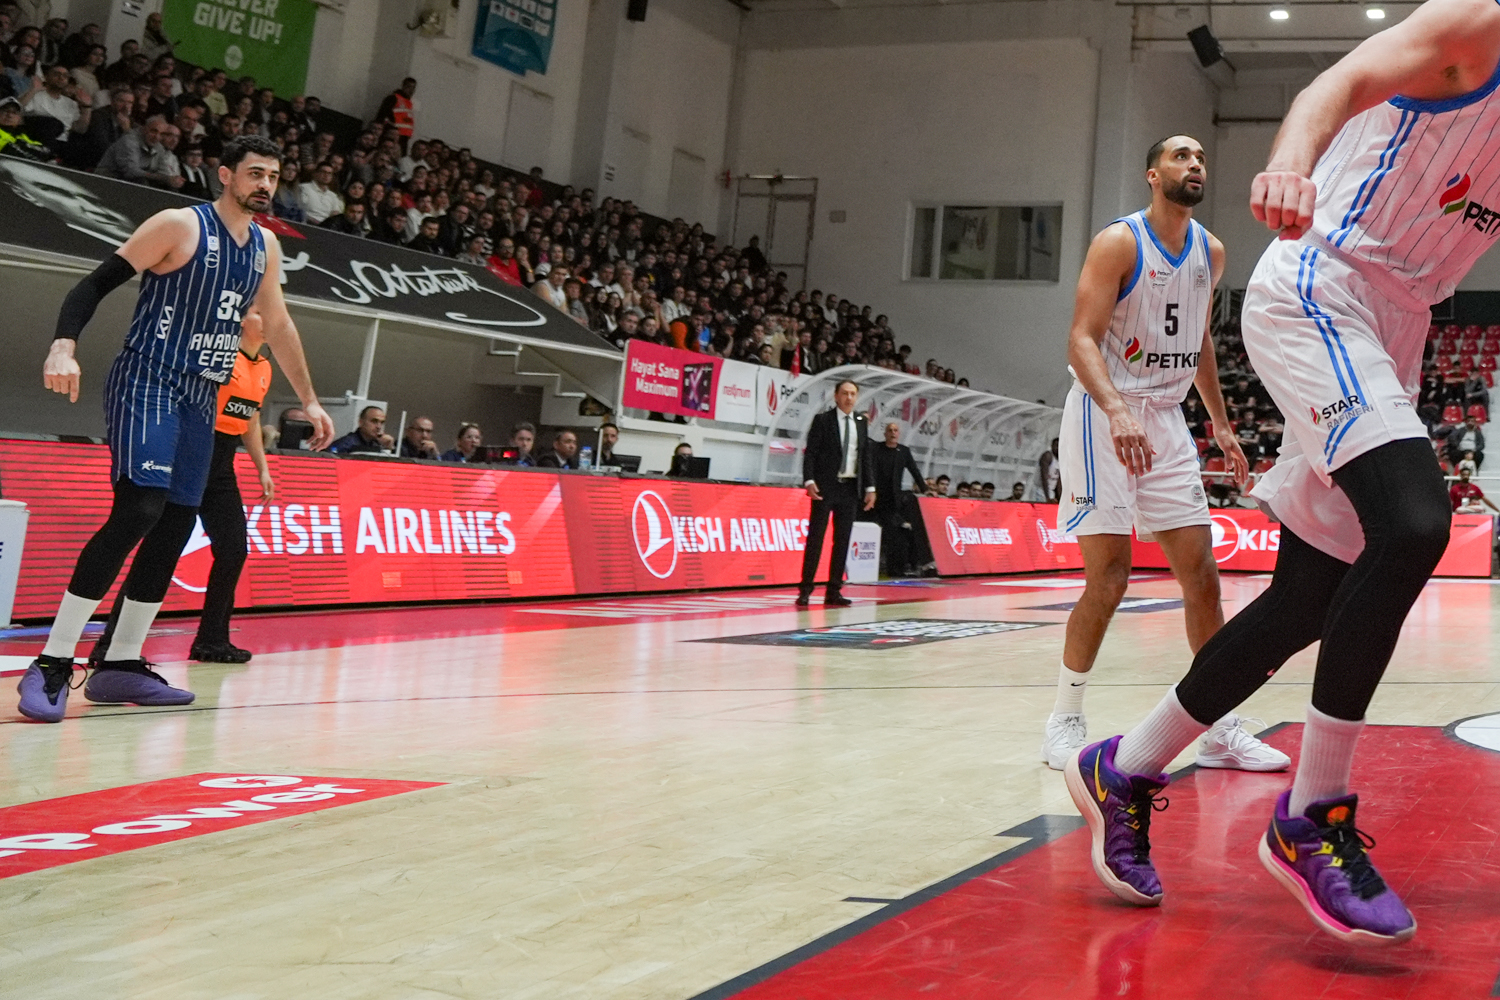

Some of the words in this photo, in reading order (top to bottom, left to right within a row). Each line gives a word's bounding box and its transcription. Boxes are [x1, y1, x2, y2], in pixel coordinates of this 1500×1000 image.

[193, 2, 246, 36] GIVE
[249, 12, 284, 45] UP!
[1164, 303, 1179, 336] 5
[198, 350, 238, 368] EFES
[631, 358, 657, 377] Hayat
[657, 362, 680, 380] Sana
[635, 377, 678, 398] Maximum
[1322, 395, 1360, 419] STAR
[1075, 496, 1094, 505] STAR
[355, 506, 516, 555] AIRLINES
